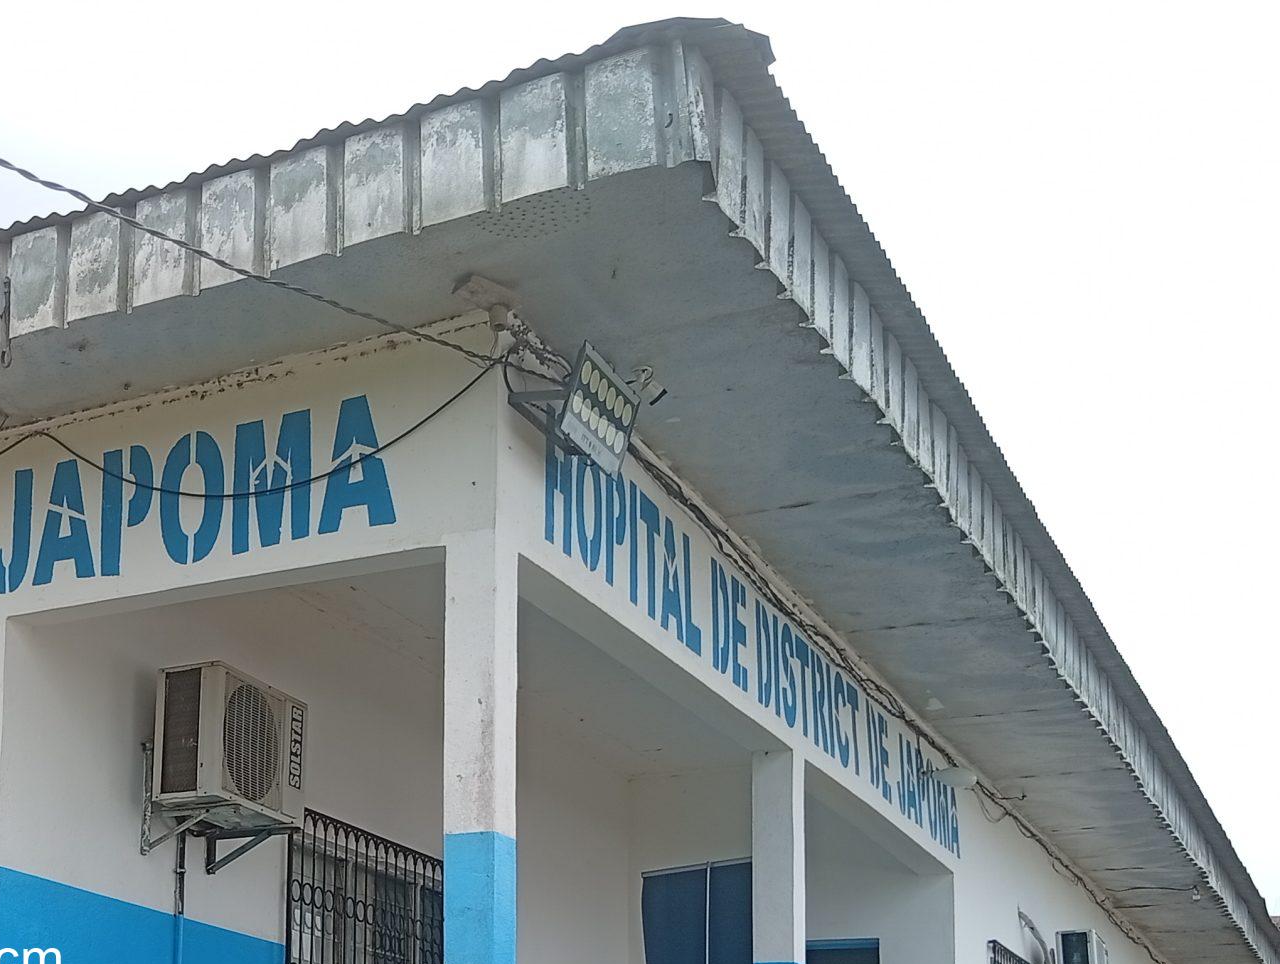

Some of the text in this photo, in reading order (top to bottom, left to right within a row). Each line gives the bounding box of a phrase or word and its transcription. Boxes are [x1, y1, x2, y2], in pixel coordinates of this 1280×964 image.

[289, 706, 304, 789] SOLSTAR
[544, 445, 961, 859] HOPITAL DE DISTRICT DE JAPOMA
